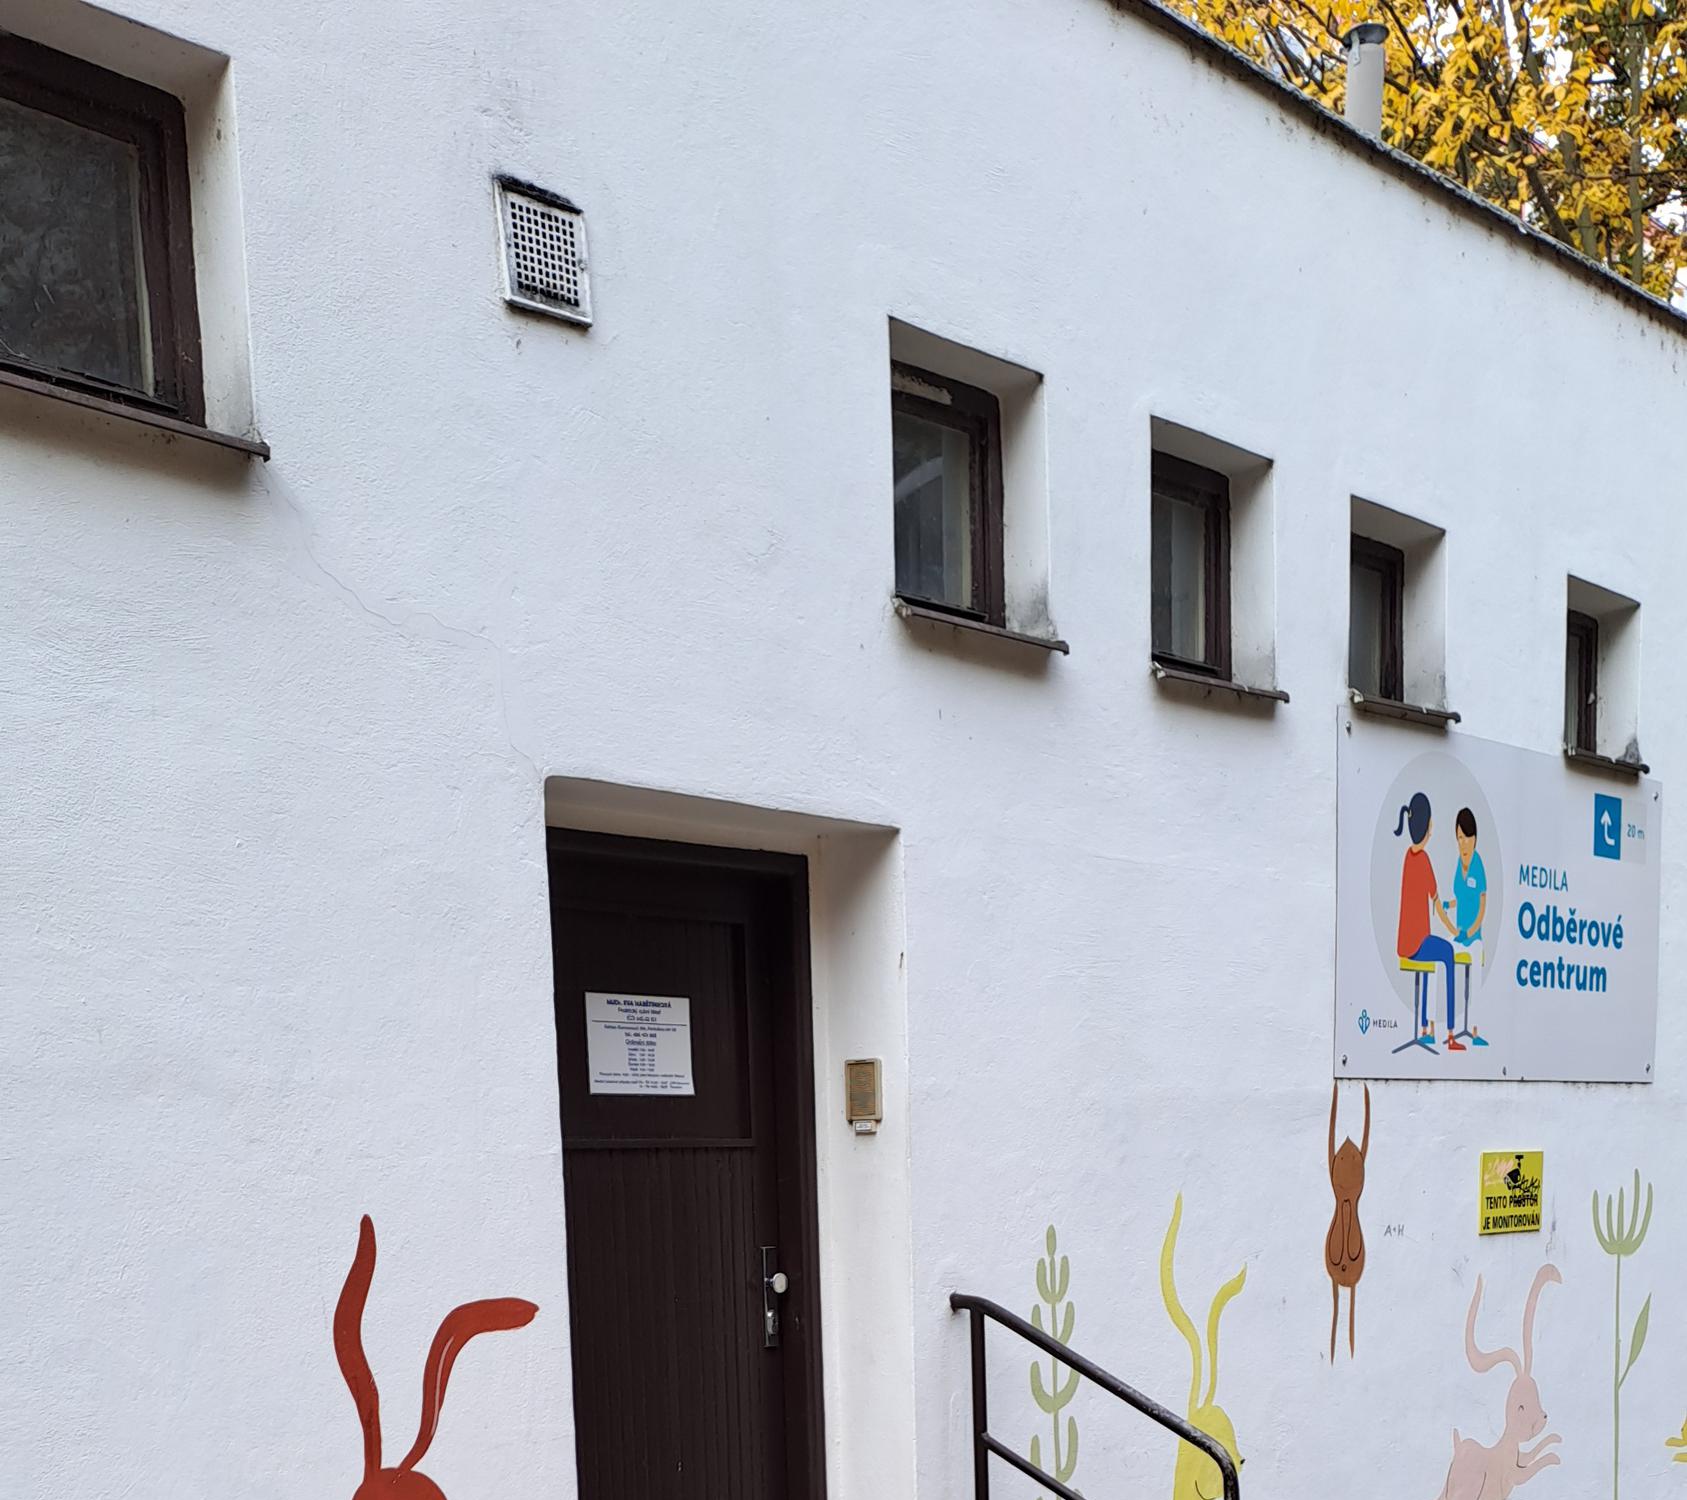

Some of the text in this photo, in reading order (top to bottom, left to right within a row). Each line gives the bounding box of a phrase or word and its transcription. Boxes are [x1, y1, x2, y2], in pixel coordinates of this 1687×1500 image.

[1627, 824, 1645, 840] 20 m
[1518, 864, 1568, 892] MEDILA
[1517, 901, 1624, 949] Odběrové
[1516, 956, 1607, 992] centrum
[1372, 1018, 1398, 1029] MEDILA
[1485, 1195, 1507, 1209] TENTO
[1483, 1210, 1540, 1230] JE MONITOROVÁN
